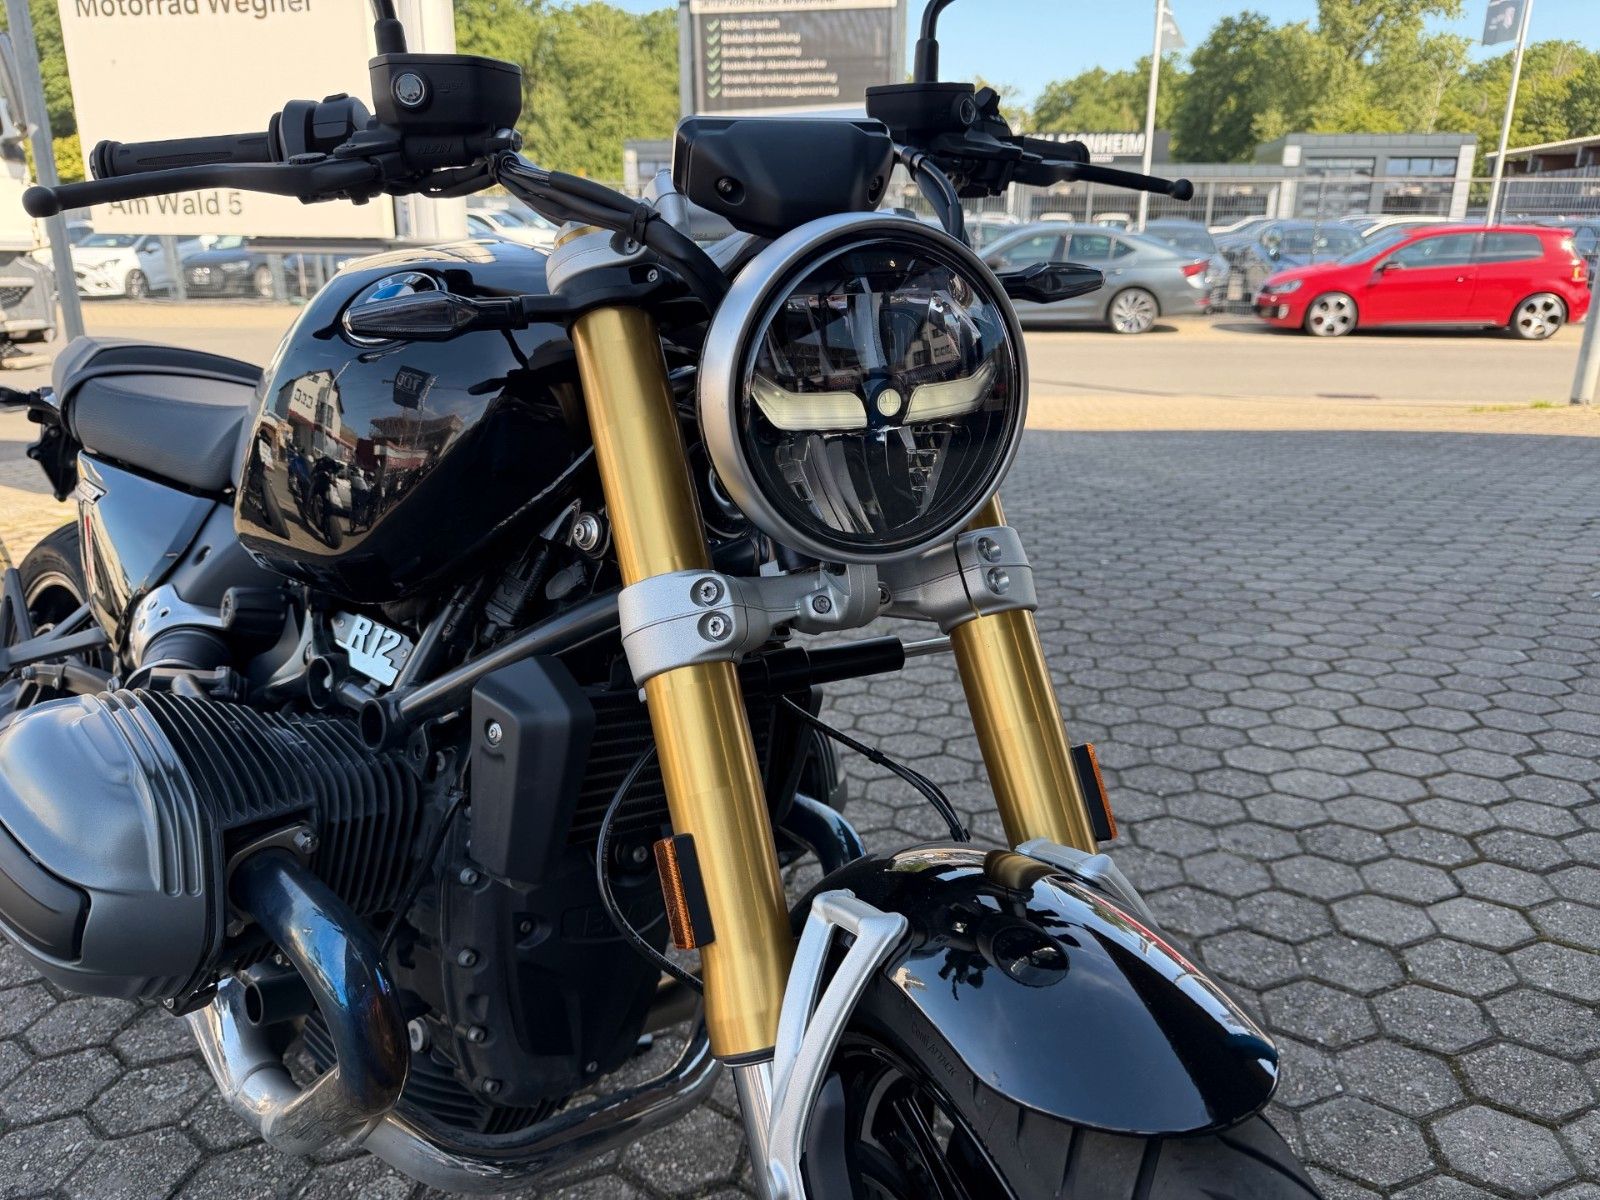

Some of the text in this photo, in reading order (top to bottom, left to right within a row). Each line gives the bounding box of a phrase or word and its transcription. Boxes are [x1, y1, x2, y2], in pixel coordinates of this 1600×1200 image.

[75, 0, 311, 19] Motorrad Wegner
[108, 190, 242, 215] Am Wald 5
[346, 614, 402, 664] R12
